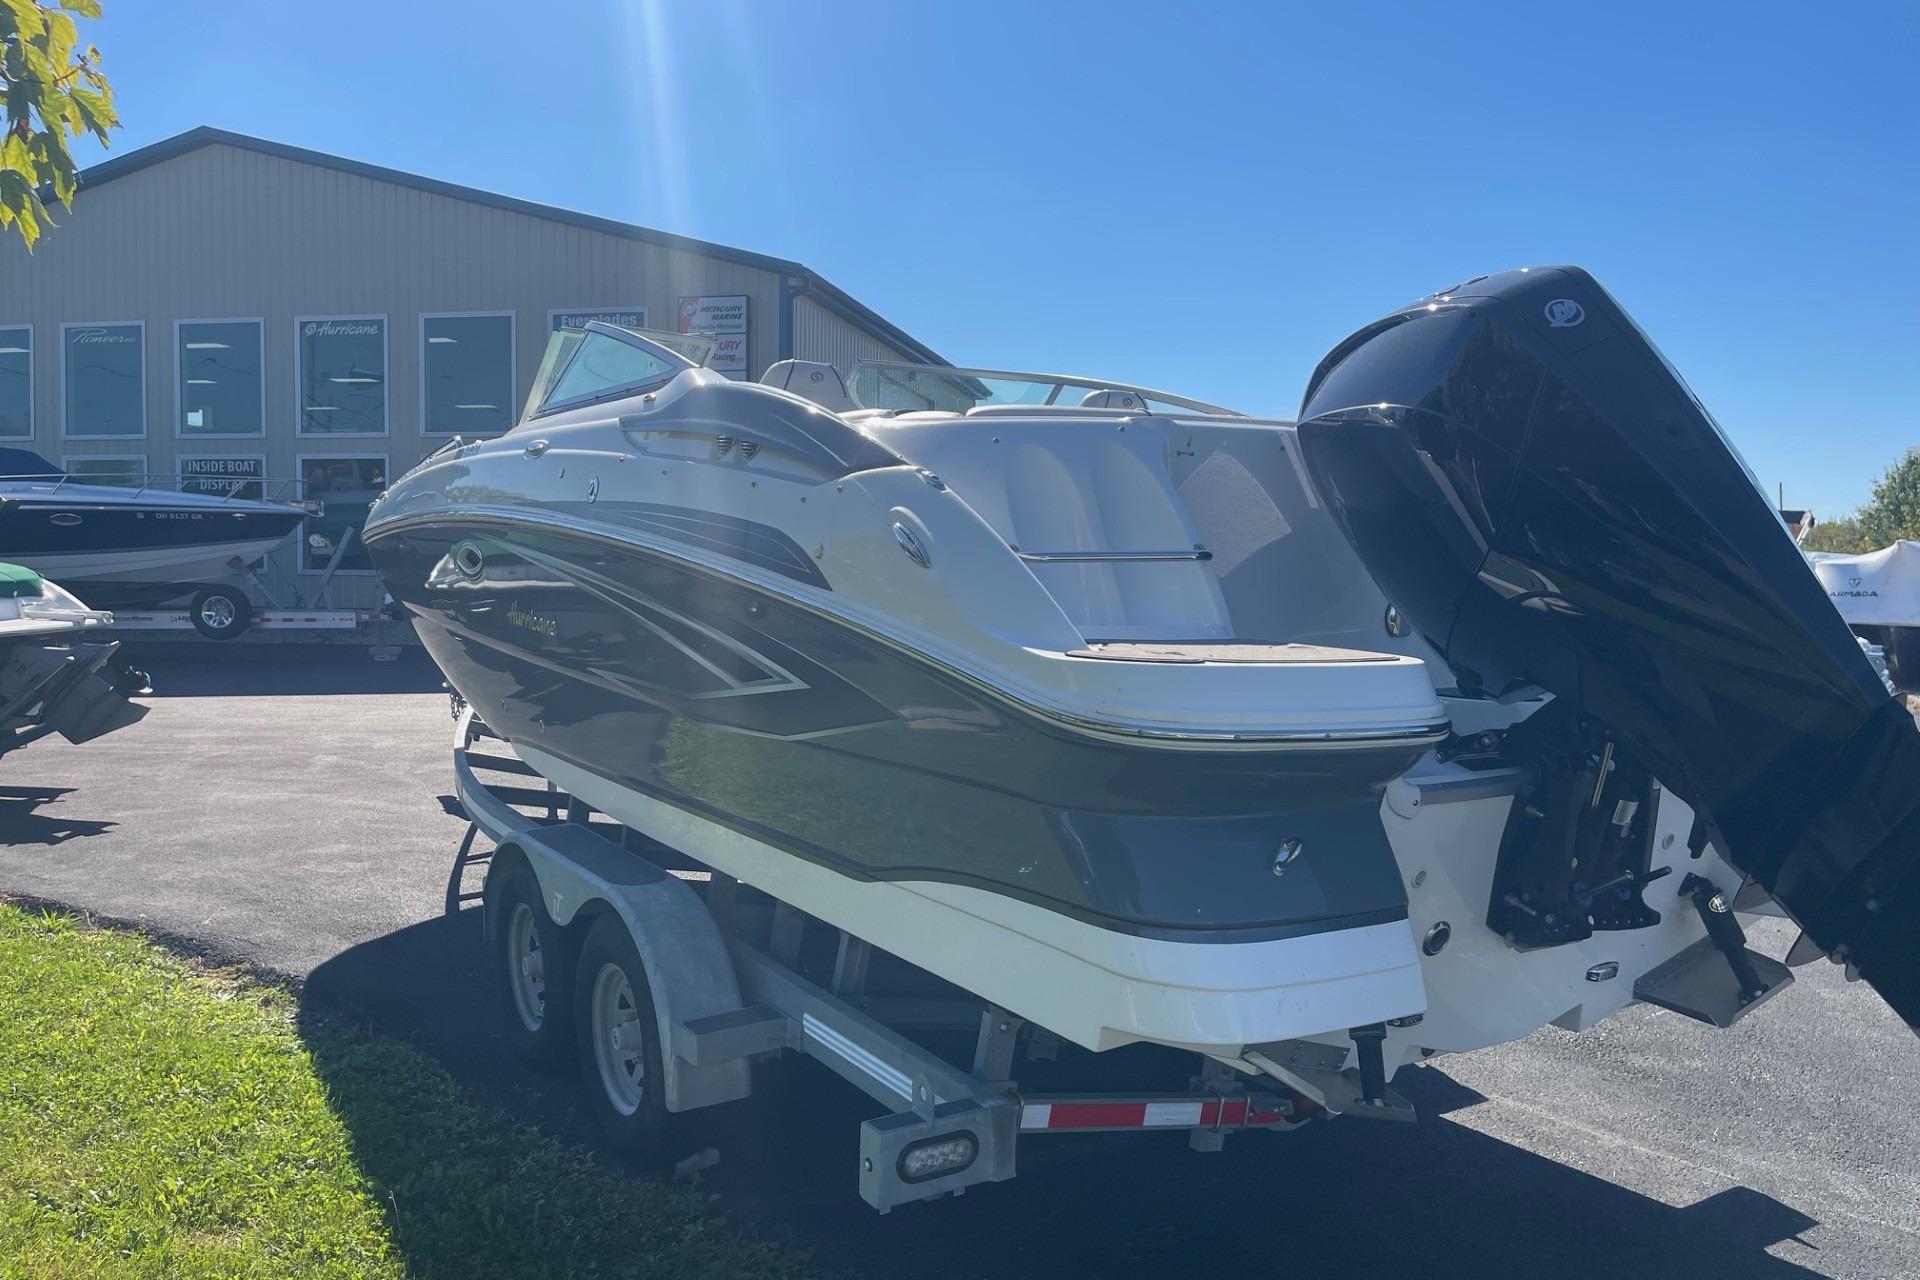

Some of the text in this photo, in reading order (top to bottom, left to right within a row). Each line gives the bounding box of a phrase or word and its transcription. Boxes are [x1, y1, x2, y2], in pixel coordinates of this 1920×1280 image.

[700, 305, 743, 313] MERCURY
[316, 320, 379, 336] Hurricane
[188, 460, 256, 473] INSIDE BOAT
[1830, 590, 1879, 598] ARMADA
[506, 599, 558, 636] Hurricane
